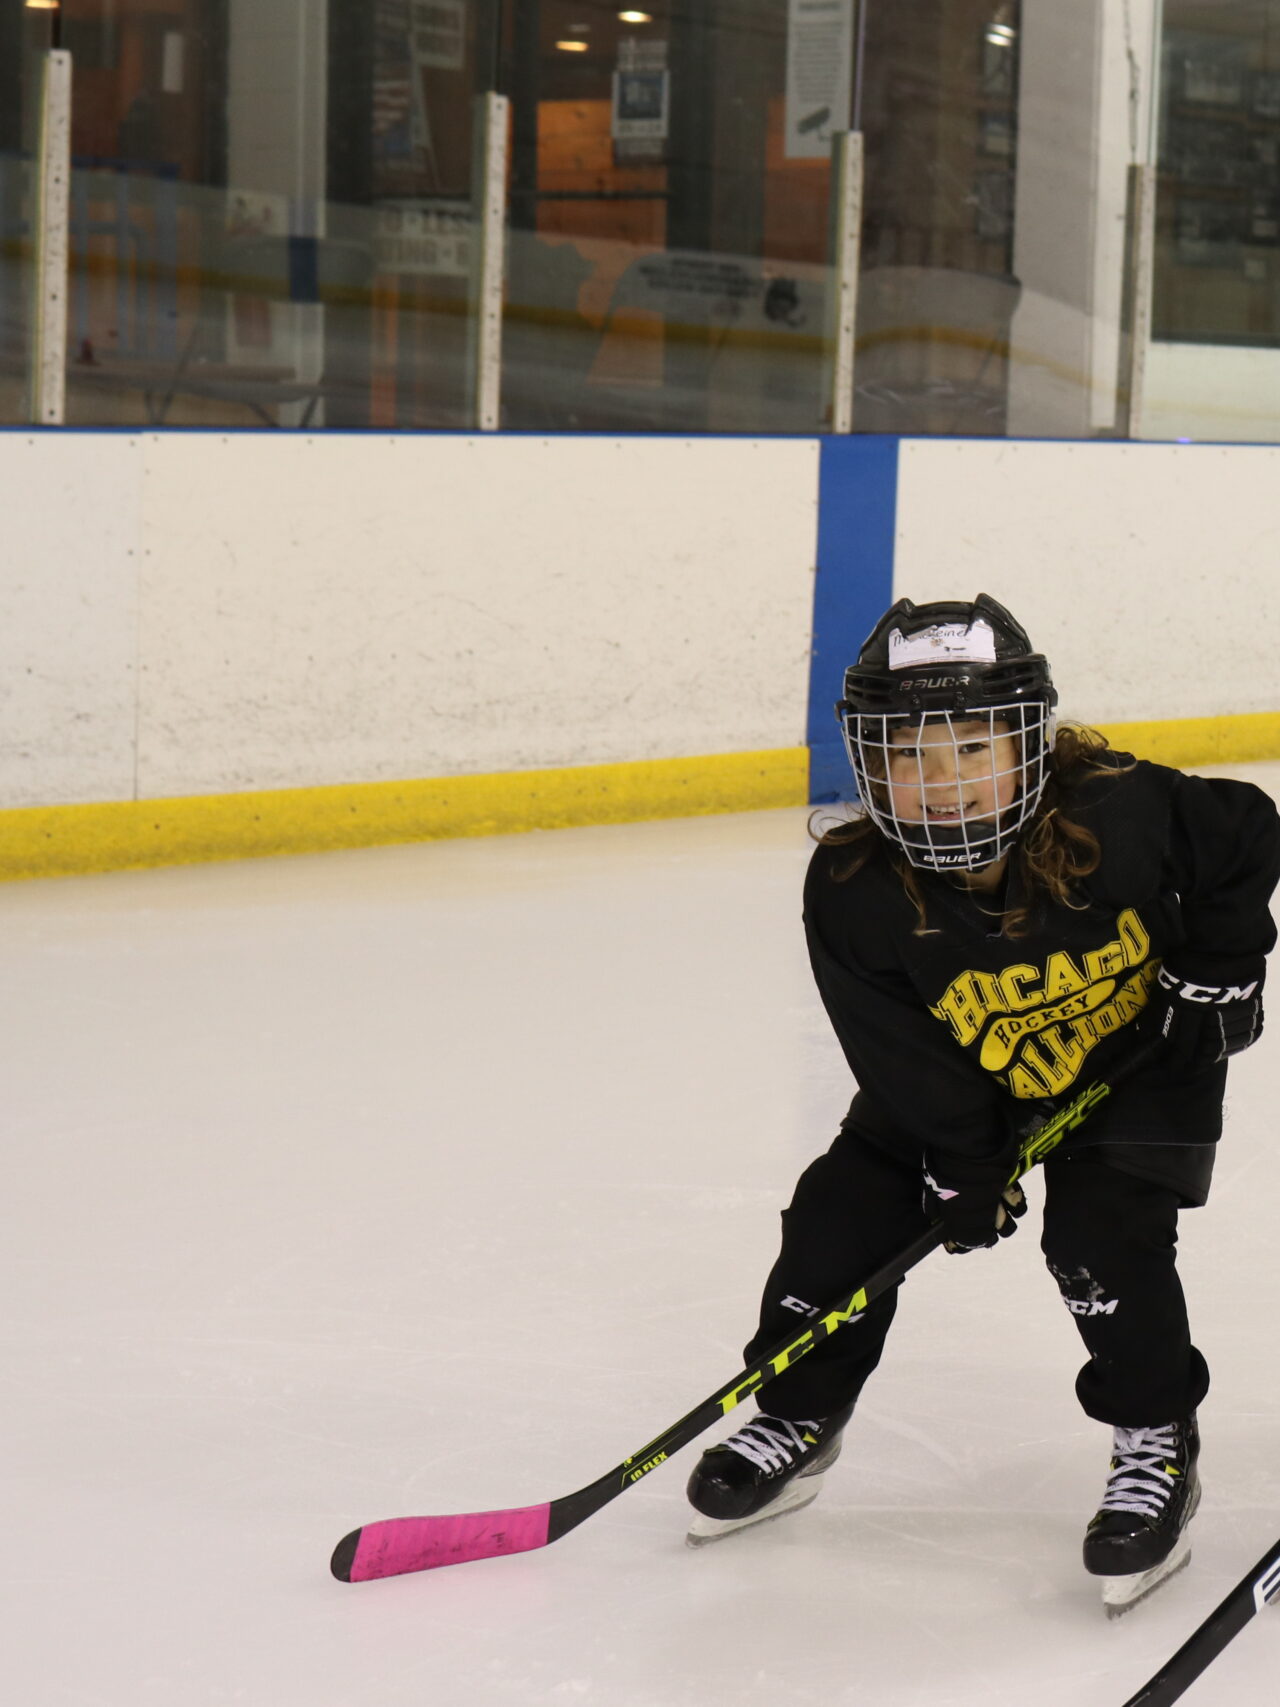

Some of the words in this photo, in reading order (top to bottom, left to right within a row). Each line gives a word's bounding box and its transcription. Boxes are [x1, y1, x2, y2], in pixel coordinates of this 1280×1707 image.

[923, 851, 982, 864] BAUER
[928, 908, 1150, 1047] HICAGO
[1158, 963, 1259, 1004] CCM
[993, 994, 1091, 1049] HOCKEY
[716, 1286, 868, 1416] CCM
[641, 1450, 668, 1471] FLEX
